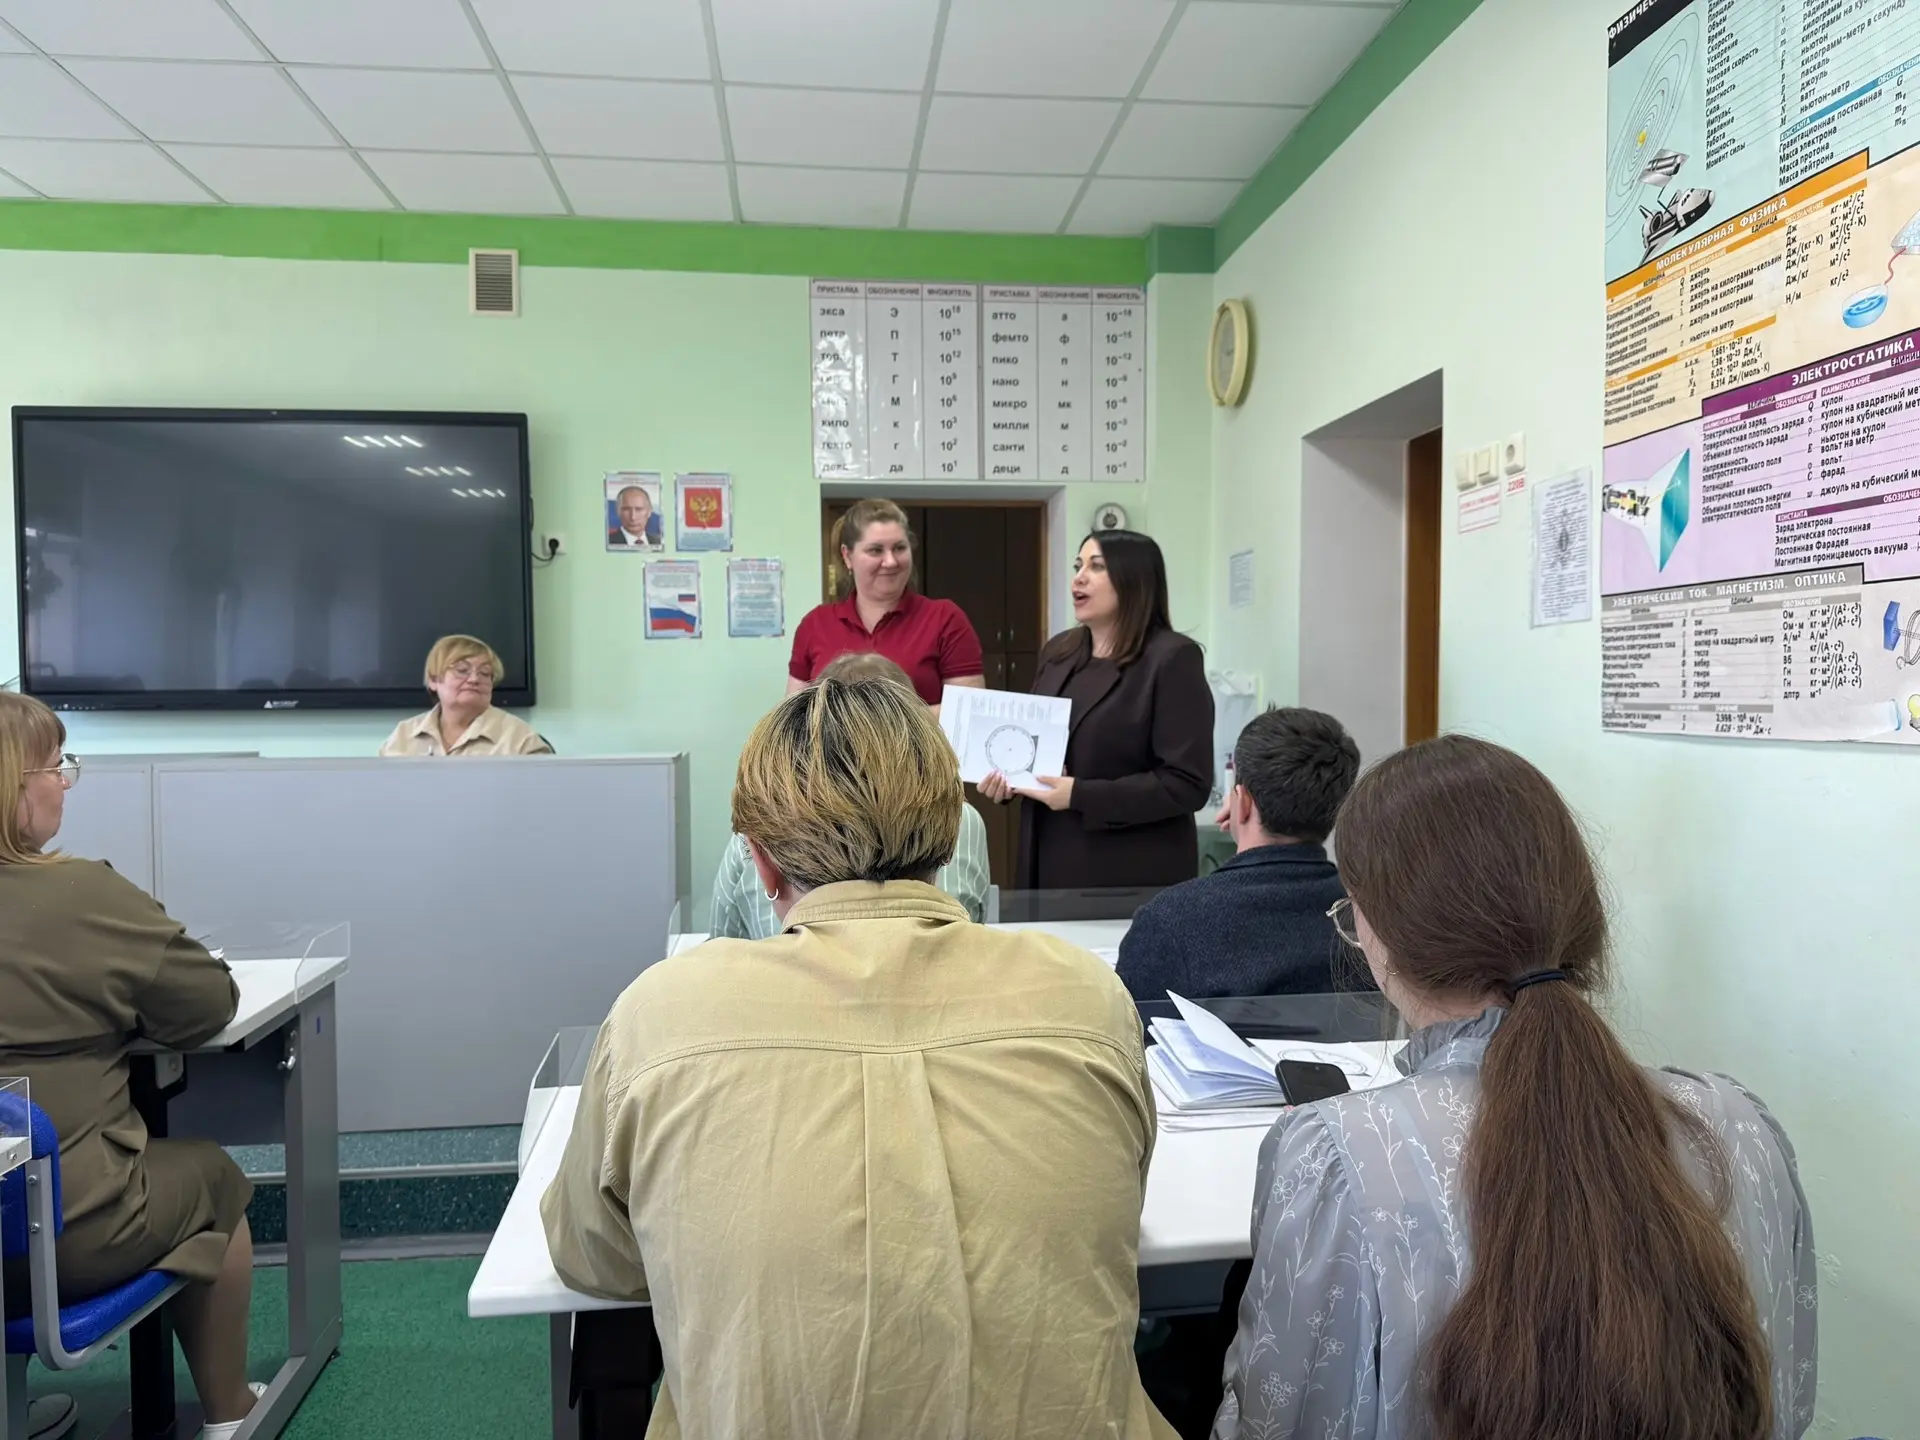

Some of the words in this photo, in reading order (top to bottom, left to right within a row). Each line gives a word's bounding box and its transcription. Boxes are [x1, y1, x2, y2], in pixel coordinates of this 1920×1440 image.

[1708, 16, 1727, 33] Объем
[1802, 12, 1841, 43] килограмм
[1843, 5, 1852, 16] на
[1803, 1, 1842, 32] килограмм
[1707, 32, 1733, 54] Скорость
[1708, 27, 1726, 44] Время
[1801, 23, 1865, 67] килограмм-метр
[1873, 0, 1905, 22] секунду
[1707, 39, 1738, 65] Ускорение
[1801, 33, 1828, 56] ньютон
[1707, 55, 1729, 74] Частота
[1707, 65, 1730, 86] Угловая
[1731, 48, 1759, 72] скорость
[1800, 57, 1830, 79] паскаль
[1706, 79, 1724, 97] Масса
[1800, 70, 1828, 92] джоуль
[1706, 84, 1735, 107] Плотность
[1800, 88, 1815, 102] ватт
[1800, 80, 1850, 114] ньютон-метр
[1706, 104, 1720, 117] Сила
[1706, 107, 1731, 128] Импульс
[1707, 117, 1734, 140] Давление
[1779, 114, 1835, 152] Гравитационная
[1837, 89, 1882, 119] постоянная
[1706, 132, 1725, 149] Работа
[1706, 138, 1735, 160] Мощность
[1780, 148, 1798, 164] Масса
[1800, 127, 1837, 152] электрона
[1706, 152, 1728, 170] Момент
[1730, 142, 1745, 156] силы
[1779, 161, 1798, 175] Масса
[1800, 142, 1829, 165] протона
[1779, 174, 1798, 187] Масса
[1800, 152, 1834, 175] нейтрона
[1657, 223, 1734, 269] МОЛЕКУЛЯРНАЯ
[1739, 197, 1787, 228] ФИЗИКА
[1751, 216, 1777, 233] ЕДИНИЦА
[1786, 225, 1797, 237] Дж
[1786, 237, 1796, 249] Дж
[1720, 254, 1781, 288] килограмм-кельвин
[1786, 254, 1809, 270] Дж/кг
[1786, 270, 1808, 286] Дж/кг
[1720, 279, 1753, 299] килограмм
[1786, 292, 1801, 304] Н/м
[890, 308, 898, 317] Э
[1720, 294, 1753, 313] килограмм
[891, 330, 898, 339] П
[992, 333, 1028, 343] фемто
[1059, 334, 1069, 345] ф
[892, 353, 898, 362] Т
[1792, 338, 1914, 386] ЭЛЕКТРОСТАТИКА
[893, 375, 898, 384] Г
[1822, 375, 1870, 395] НАИМЕНОВАНИЕ
[891, 397, 900, 406] М
[992, 401, 1027, 410] микро
[1775, 392, 1814, 408] ОБОЗНАЧЕНИЕ
[1821, 396, 1843, 407] кулон
[1821, 408, 1843, 419] кулон
[1845, 404, 1854, 412] на
[1856, 390, 1904, 412] квадратный
[1821, 419, 1843, 431] кулон
[1845, 415, 1854, 424] на
[1857, 401, 1902, 423] кубический
[1703, 422, 1747, 440] Электрический
[1749, 417, 1766, 429] заряд
[1748, 425, 1779, 439] плотность
[1781, 418, 1804, 430] заряда
[1821, 430, 1849, 444] ньютон
[1851, 428, 1860, 436] на
[1863, 422, 1885, 435] кулон
[1733, 440, 1764, 454] плотность
[1766, 434, 1788, 446] заряда
[1821, 442, 1842, 453] вольт
[1844, 439, 1853, 447] на
[1856, 434, 1874, 445] метр
[889, 464, 903, 473] да
[993, 466, 1020, 474] деци
[1821, 455, 1842, 466] вольт
[1061, 467, 1069, 475] д
[1821, 467, 1845, 480] фарад
[1747, 483, 1772, 494] емкость
[1821, 484, 1849, 496] джоуль
[1851, 481, 1859, 489] на
[1862, 470, 1908, 488] кубический
[1776, 524, 1794, 534] Заряд
[1796, 517, 1832, 531] электрона
[1776, 530, 1825, 544] Электрическая
[1827, 523, 1871, 536] постоянная
[1775, 544, 1813, 556] Постоянная
[1815, 539, 1849, 550] Фарадея
[1775, 554, 1810, 567] Магнитная
[1813, 547, 1872, 563] проницаемость
[1874, 542, 1908, 555] вакуума
[1689, 587, 1711, 598] ТОК.
[1717, 579, 1787, 595] МАГНЕТИЗМ.
[1795, 572, 1846, 587] ОПТИКА
[1783, 611, 1793, 619] Ом
[1784, 655, 1791, 664] Вб
